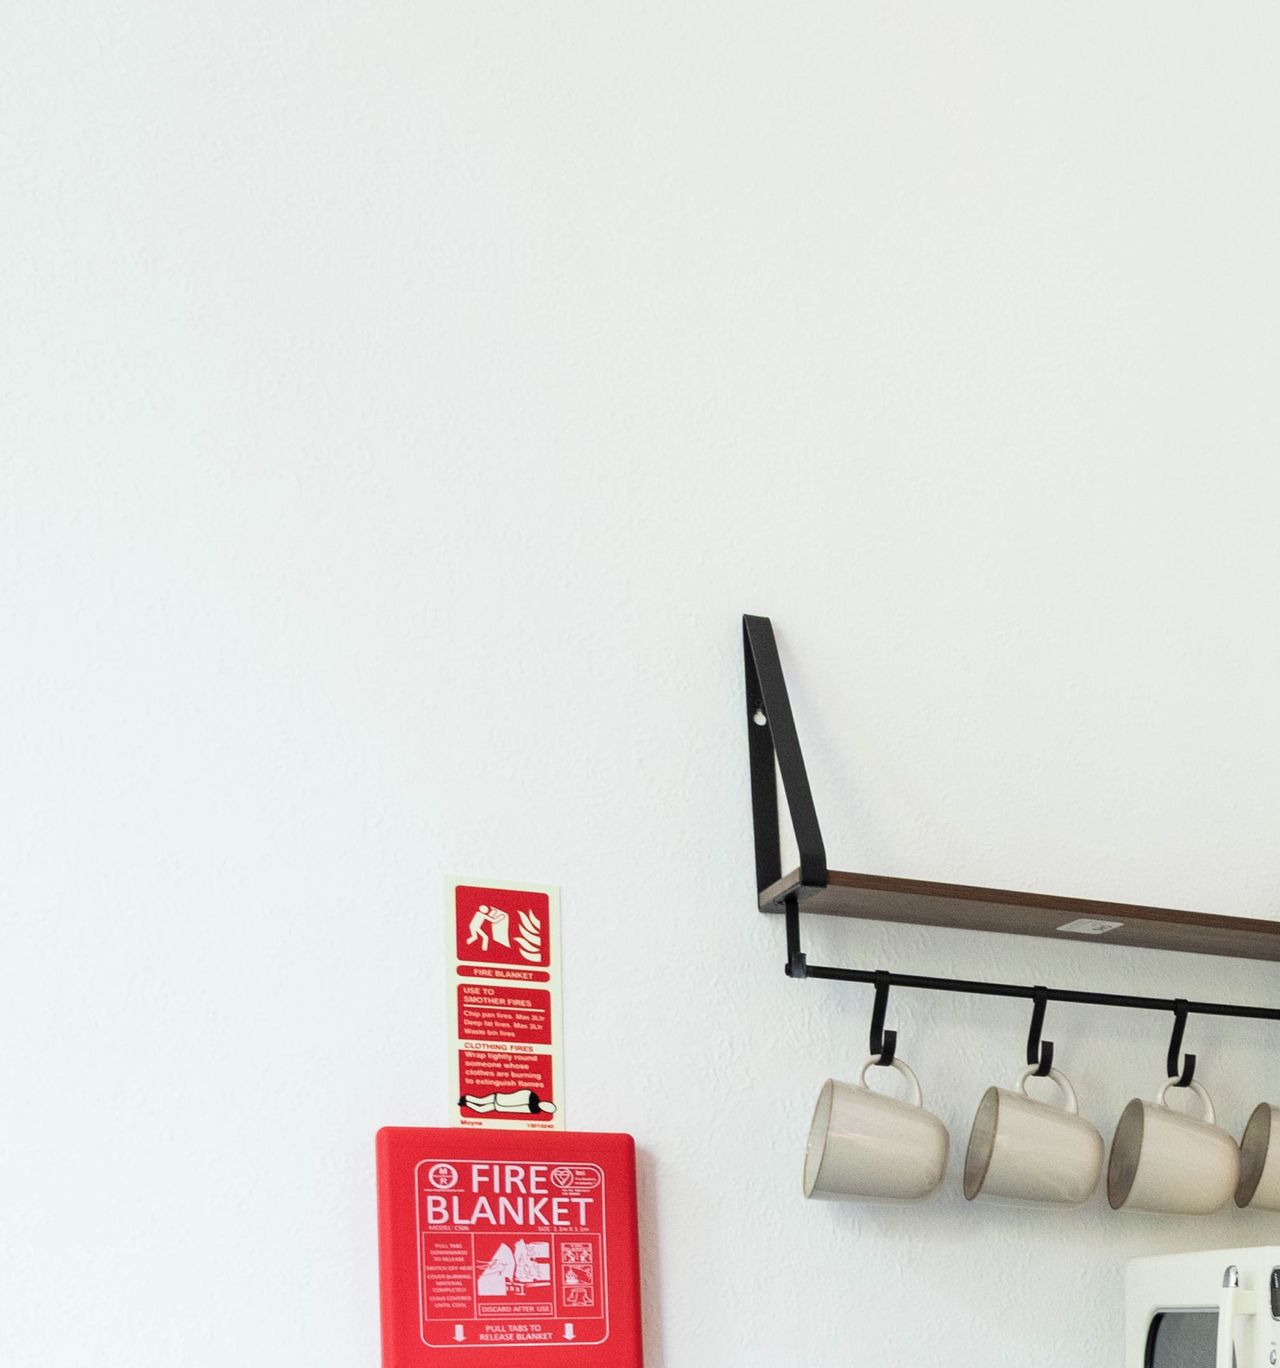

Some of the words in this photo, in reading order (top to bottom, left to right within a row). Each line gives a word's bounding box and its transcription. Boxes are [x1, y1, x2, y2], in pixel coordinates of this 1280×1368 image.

[474, 968, 494, 977] FIRE
[495, 970, 534, 980] BLANKET
[463, 987, 481, 995] USE
[482, 988, 495, 996] TO
[463, 995, 505, 1005] SMOTHER
[507, 998, 532, 1007] FIRES
[464, 1042, 508, 1051] CLOTHING
[510, 1044, 534, 1053] FIRES
[464, 1051, 487, 1060] Wrap
[513, 1054, 538, 1062] round
[465, 1061, 502, 1069] someone
[503, 1063, 530, 1071] whose
[465, 1069, 495, 1077] clothes
[510, 1072, 542, 1082] burning
[475, 1079, 517, 1088] extinguish
[471, 1164, 549, 1195] FIRE
[426, 1195, 594, 1226] BLANKET
[482, 1305, 512, 1313] DISCARD
[513, 1305, 535, 1313] AFTER
[485, 1325, 506, 1333] PULL
[507, 1324, 528, 1332] TABS
[529, 1324, 542, 1332] TO
[480, 1333, 514, 1341] RELEASE
[516, 1332, 553, 1341] BLANKET
